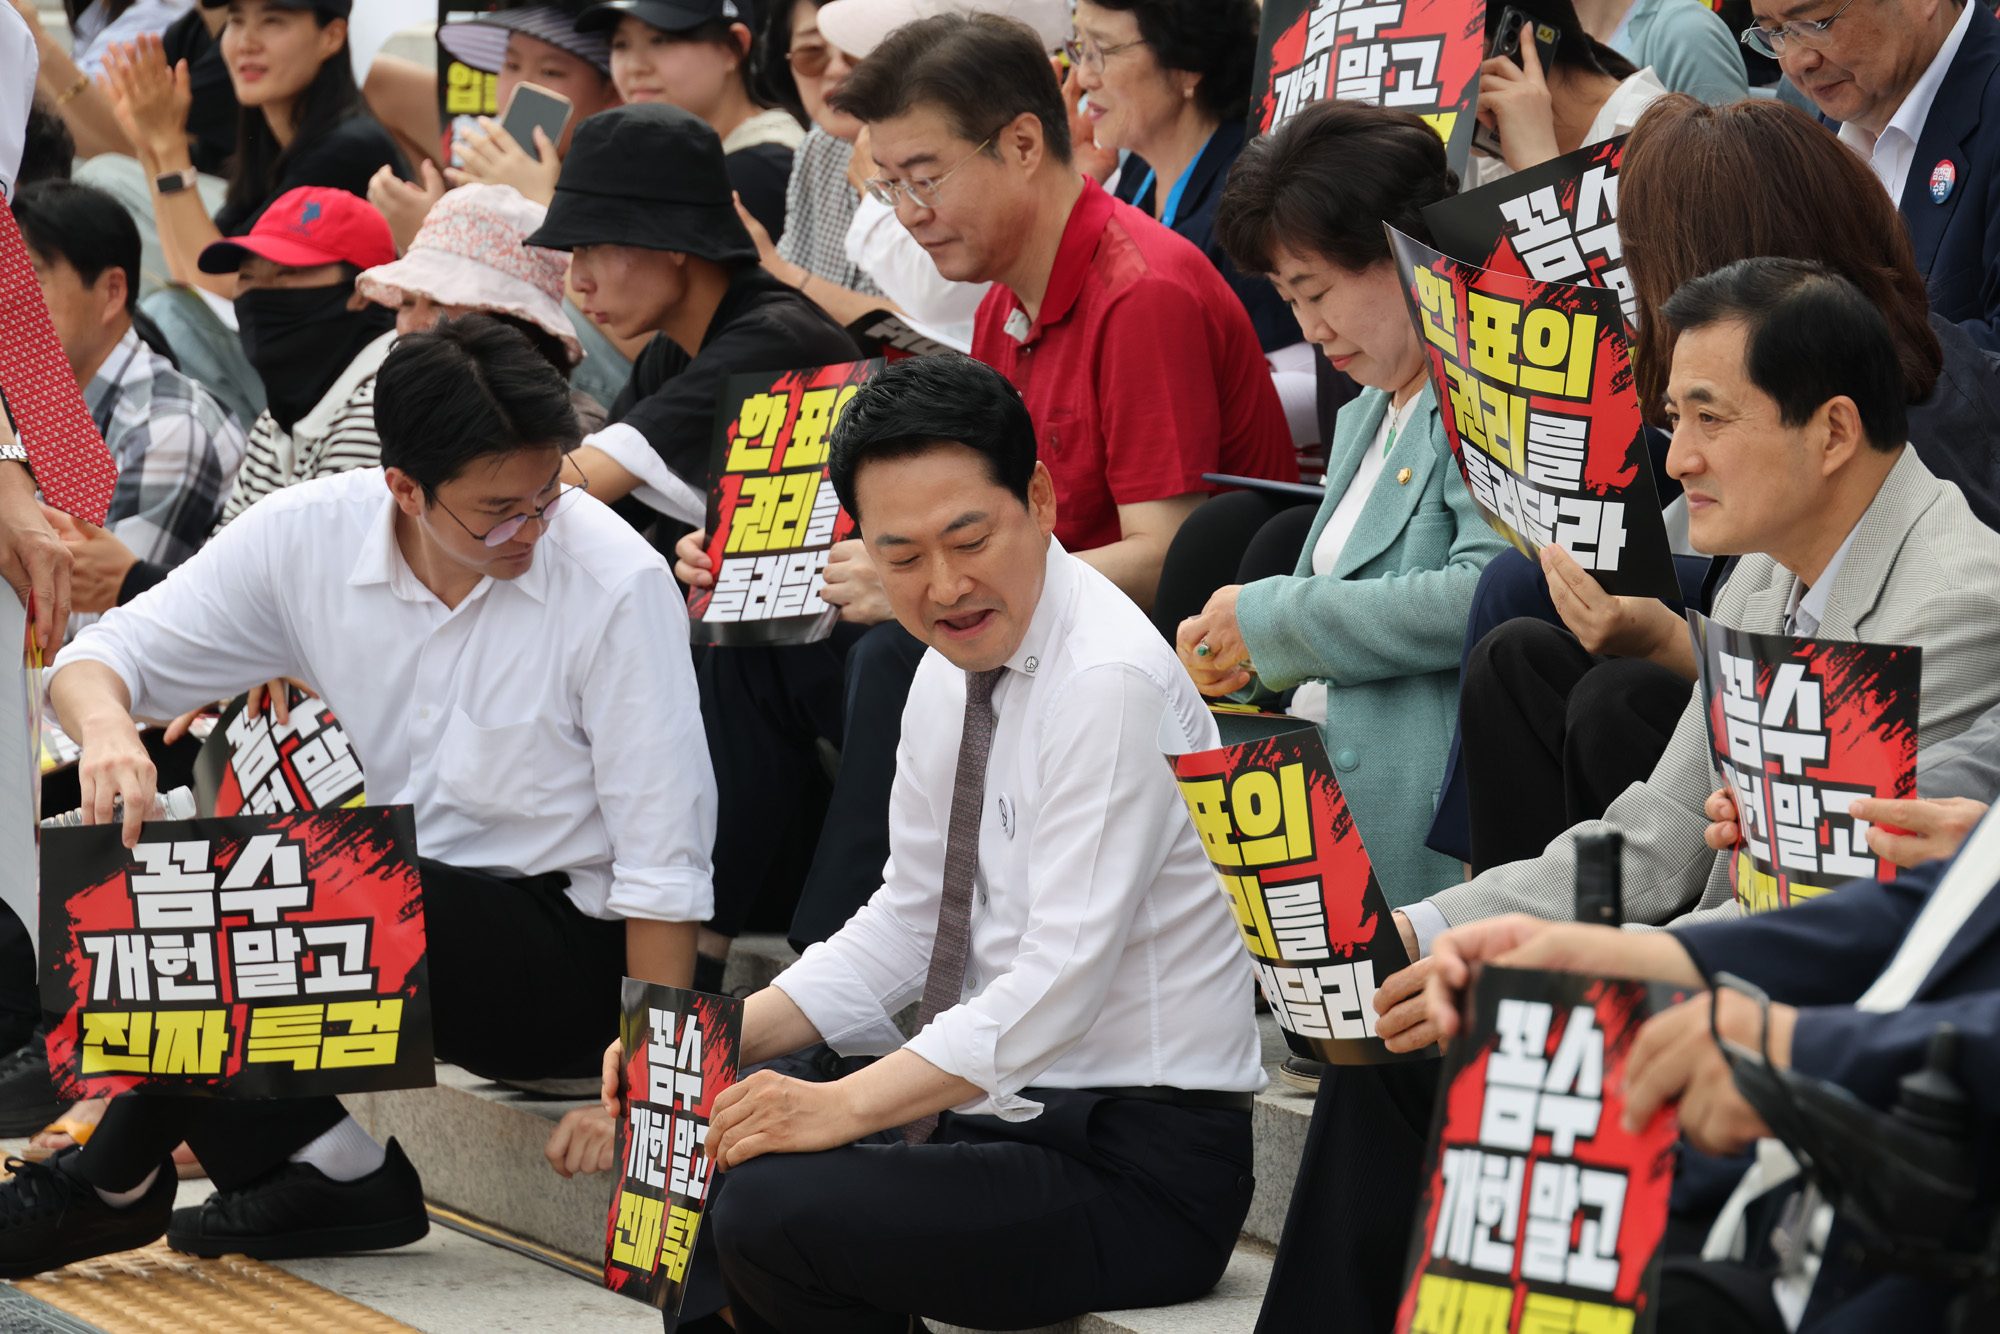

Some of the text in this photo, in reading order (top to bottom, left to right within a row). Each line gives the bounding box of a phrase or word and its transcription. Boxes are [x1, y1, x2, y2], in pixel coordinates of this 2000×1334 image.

[1336, 40, 1440, 107] 말고
[1932, 181, 1946, 196] 수호
[1413, 264, 1459, 359] 한
[1468, 292, 1598, 398] 표의
[725, 385, 860, 472] 한 표
[1443, 358, 1587, 491] 권리를
[724, 471, 839, 553] 권리를
[1460, 438, 1627, 571] 돌려달라
[1718, 651, 1826, 775] 꼼수
[1177, 762, 1312, 866] 표의
[1772, 781, 1876, 878] 말고
[131, 834, 308, 928] 꼼수
[83, 924, 373, 1000] 개헌 말고
[81, 999, 403, 1074] 진짜 특검
[647, 1007, 702, 1111] 꼼수
[1479, 999, 1604, 1157] 꼼수
[627, 1107, 708, 1200] 개헌 말고
[612, 1190, 665, 1272] 진짜
[1431, 1147, 1629, 1293] 개헌 말고
